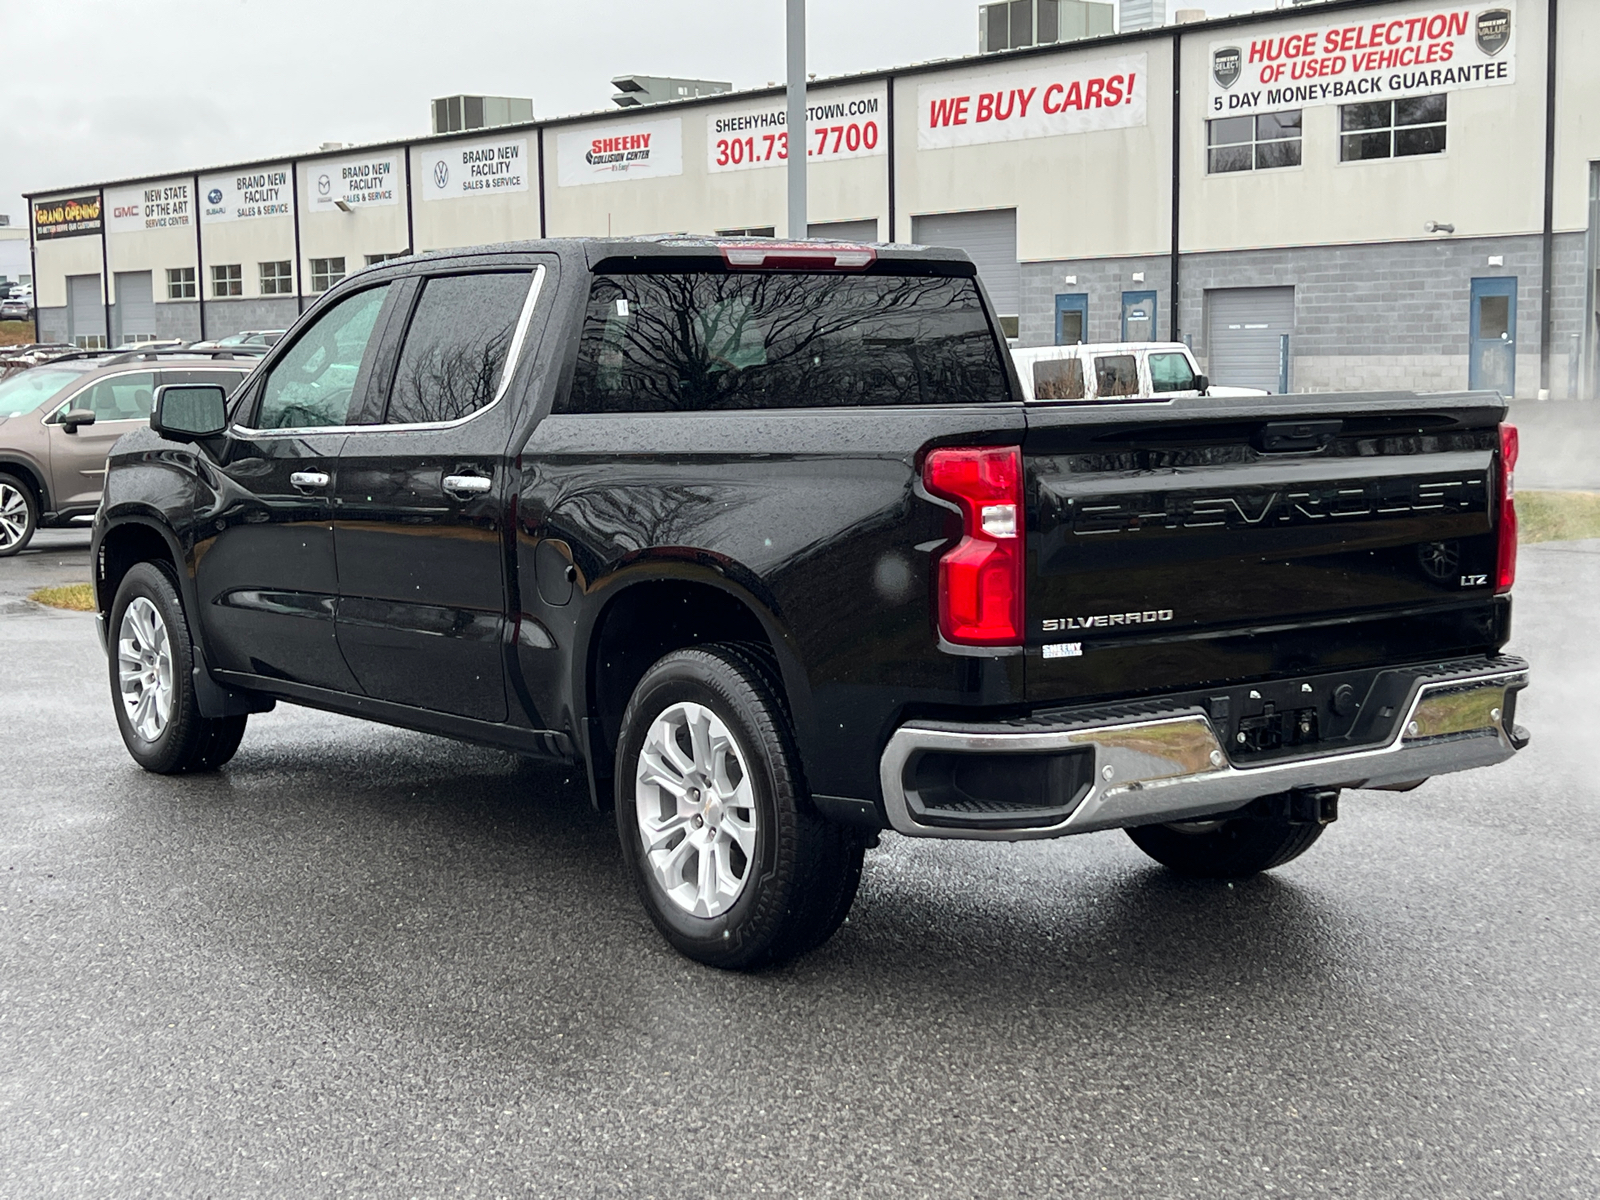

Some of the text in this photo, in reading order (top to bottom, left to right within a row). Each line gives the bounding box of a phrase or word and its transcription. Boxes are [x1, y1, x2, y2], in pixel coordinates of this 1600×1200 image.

[1248, 11, 1469, 64] HUGE SELECTION
[1478, 25, 1508, 36] VALUE
[1215, 61, 1239, 71] SELECT
[1259, 41, 1454, 84] OF USED VEHICLES
[1214, 61, 1508, 111] 5 DAY MONEY-BACK GUARANTEE
[930, 73, 1136, 128] WE BUY CARS!
[592, 133, 651, 154] SHEEHY
[716, 121, 879, 166] 301.73.7700
[462, 145, 519, 164] BRAND NEW
[592, 150, 650, 165] COLLISION CENTER
[342, 162, 390, 179] BRAND NEW
[471, 161, 511, 177] FACILITY
[236, 172, 286, 190] BRAND NEW
[349, 176, 384, 191] FACILITY
[462, 176, 521, 190] SALES & SERVICE
[144, 185, 188, 203] NEW STATE
[244, 187, 279, 203] FACILITY
[342, 193, 360, 203] SALES
[361, 193, 366, 202] &
[367, 190, 392, 201] SERVICE
[37, 203, 99, 224] GRAND OPENING
[113, 205, 140, 218] GMC
[144, 201, 188, 217] OF THE ART
[206, 207, 226, 215] SUBARU
[237, 203, 288, 217] SALES & SERVICE
[145, 215, 189, 228] SERVICE CENTER
[1460, 574, 1488, 586] LTZ
[1042, 609, 1174, 631] SILVERADO
